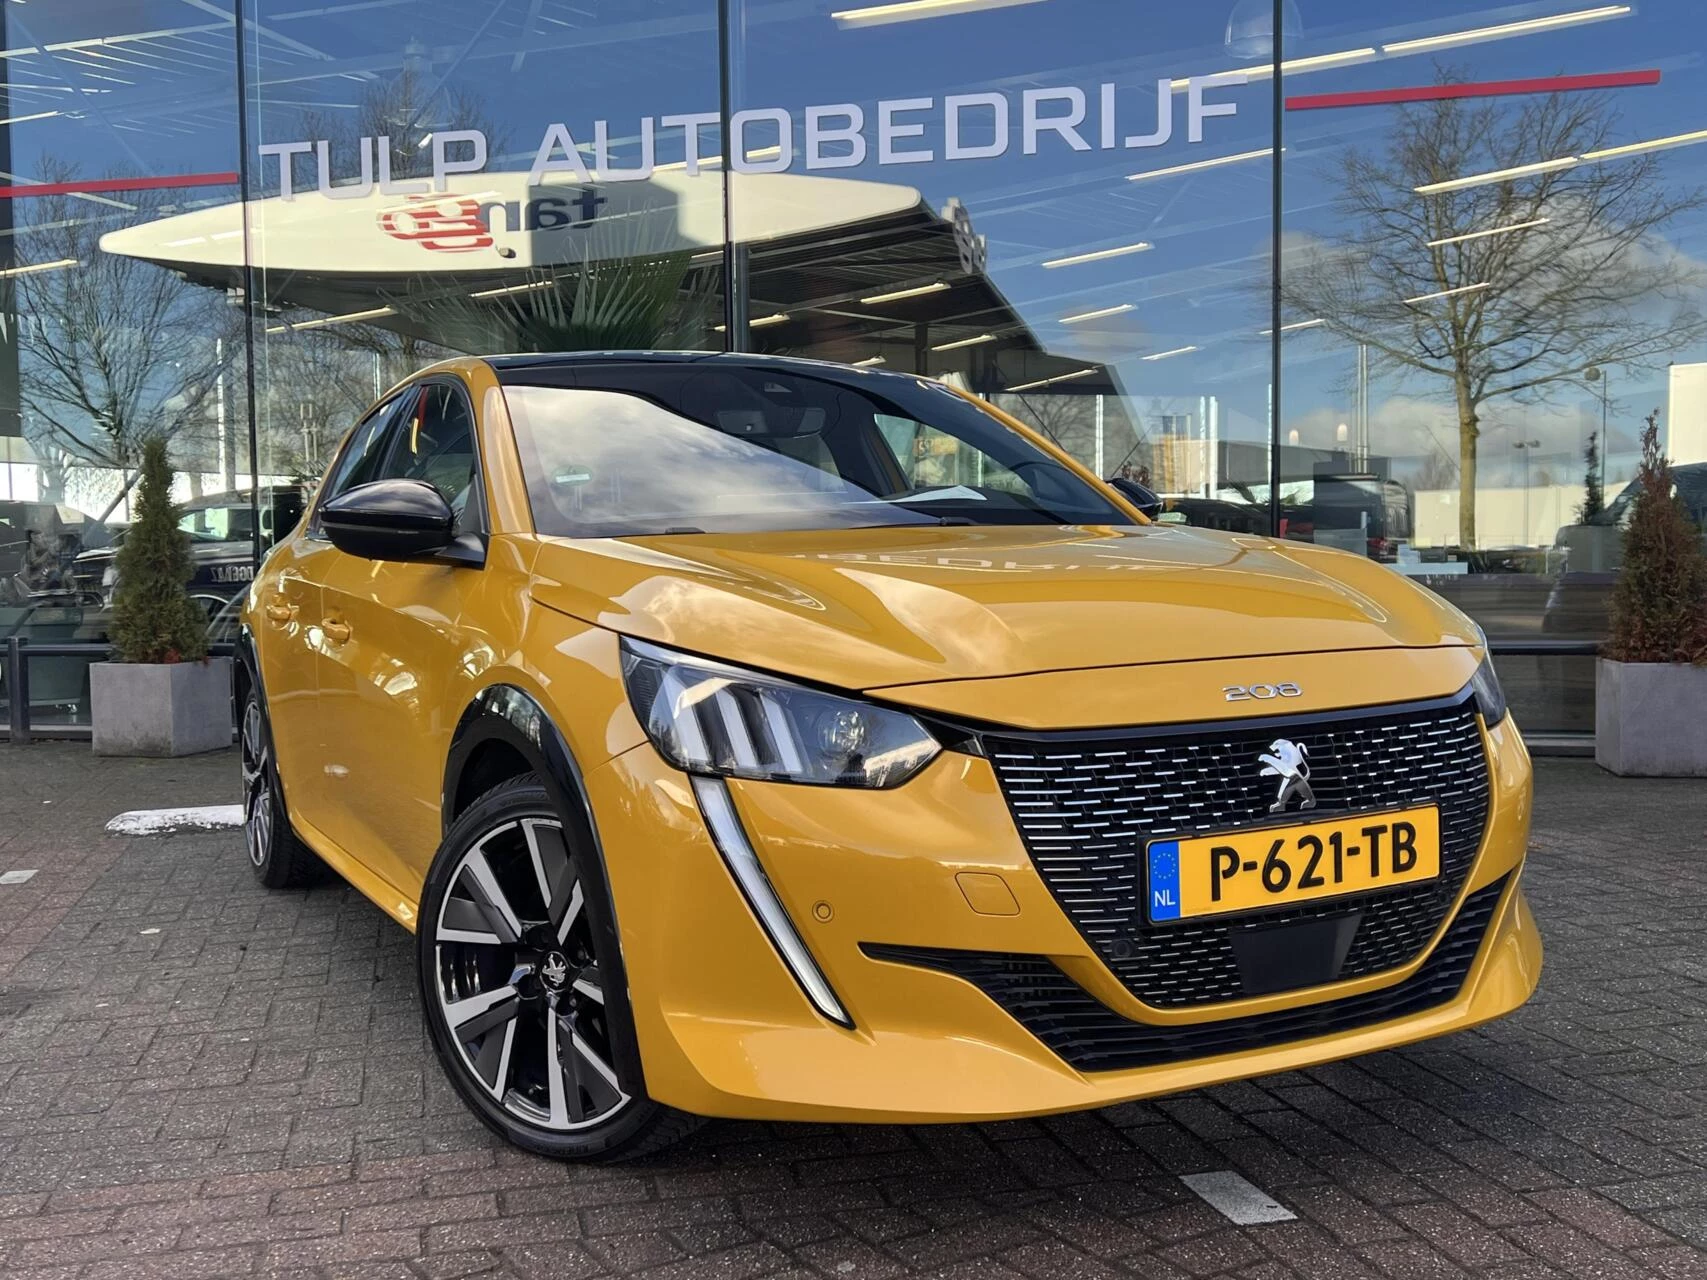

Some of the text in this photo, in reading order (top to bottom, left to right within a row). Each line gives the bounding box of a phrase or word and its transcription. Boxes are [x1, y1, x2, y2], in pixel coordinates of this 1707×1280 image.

[258, 73, 1249, 202] TULP AUTOBEDRIJF
[1222, 682, 1302, 702] 208
[1210, 821, 1417, 902] P-621-TB
[1154, 890, 1177, 907] NL
